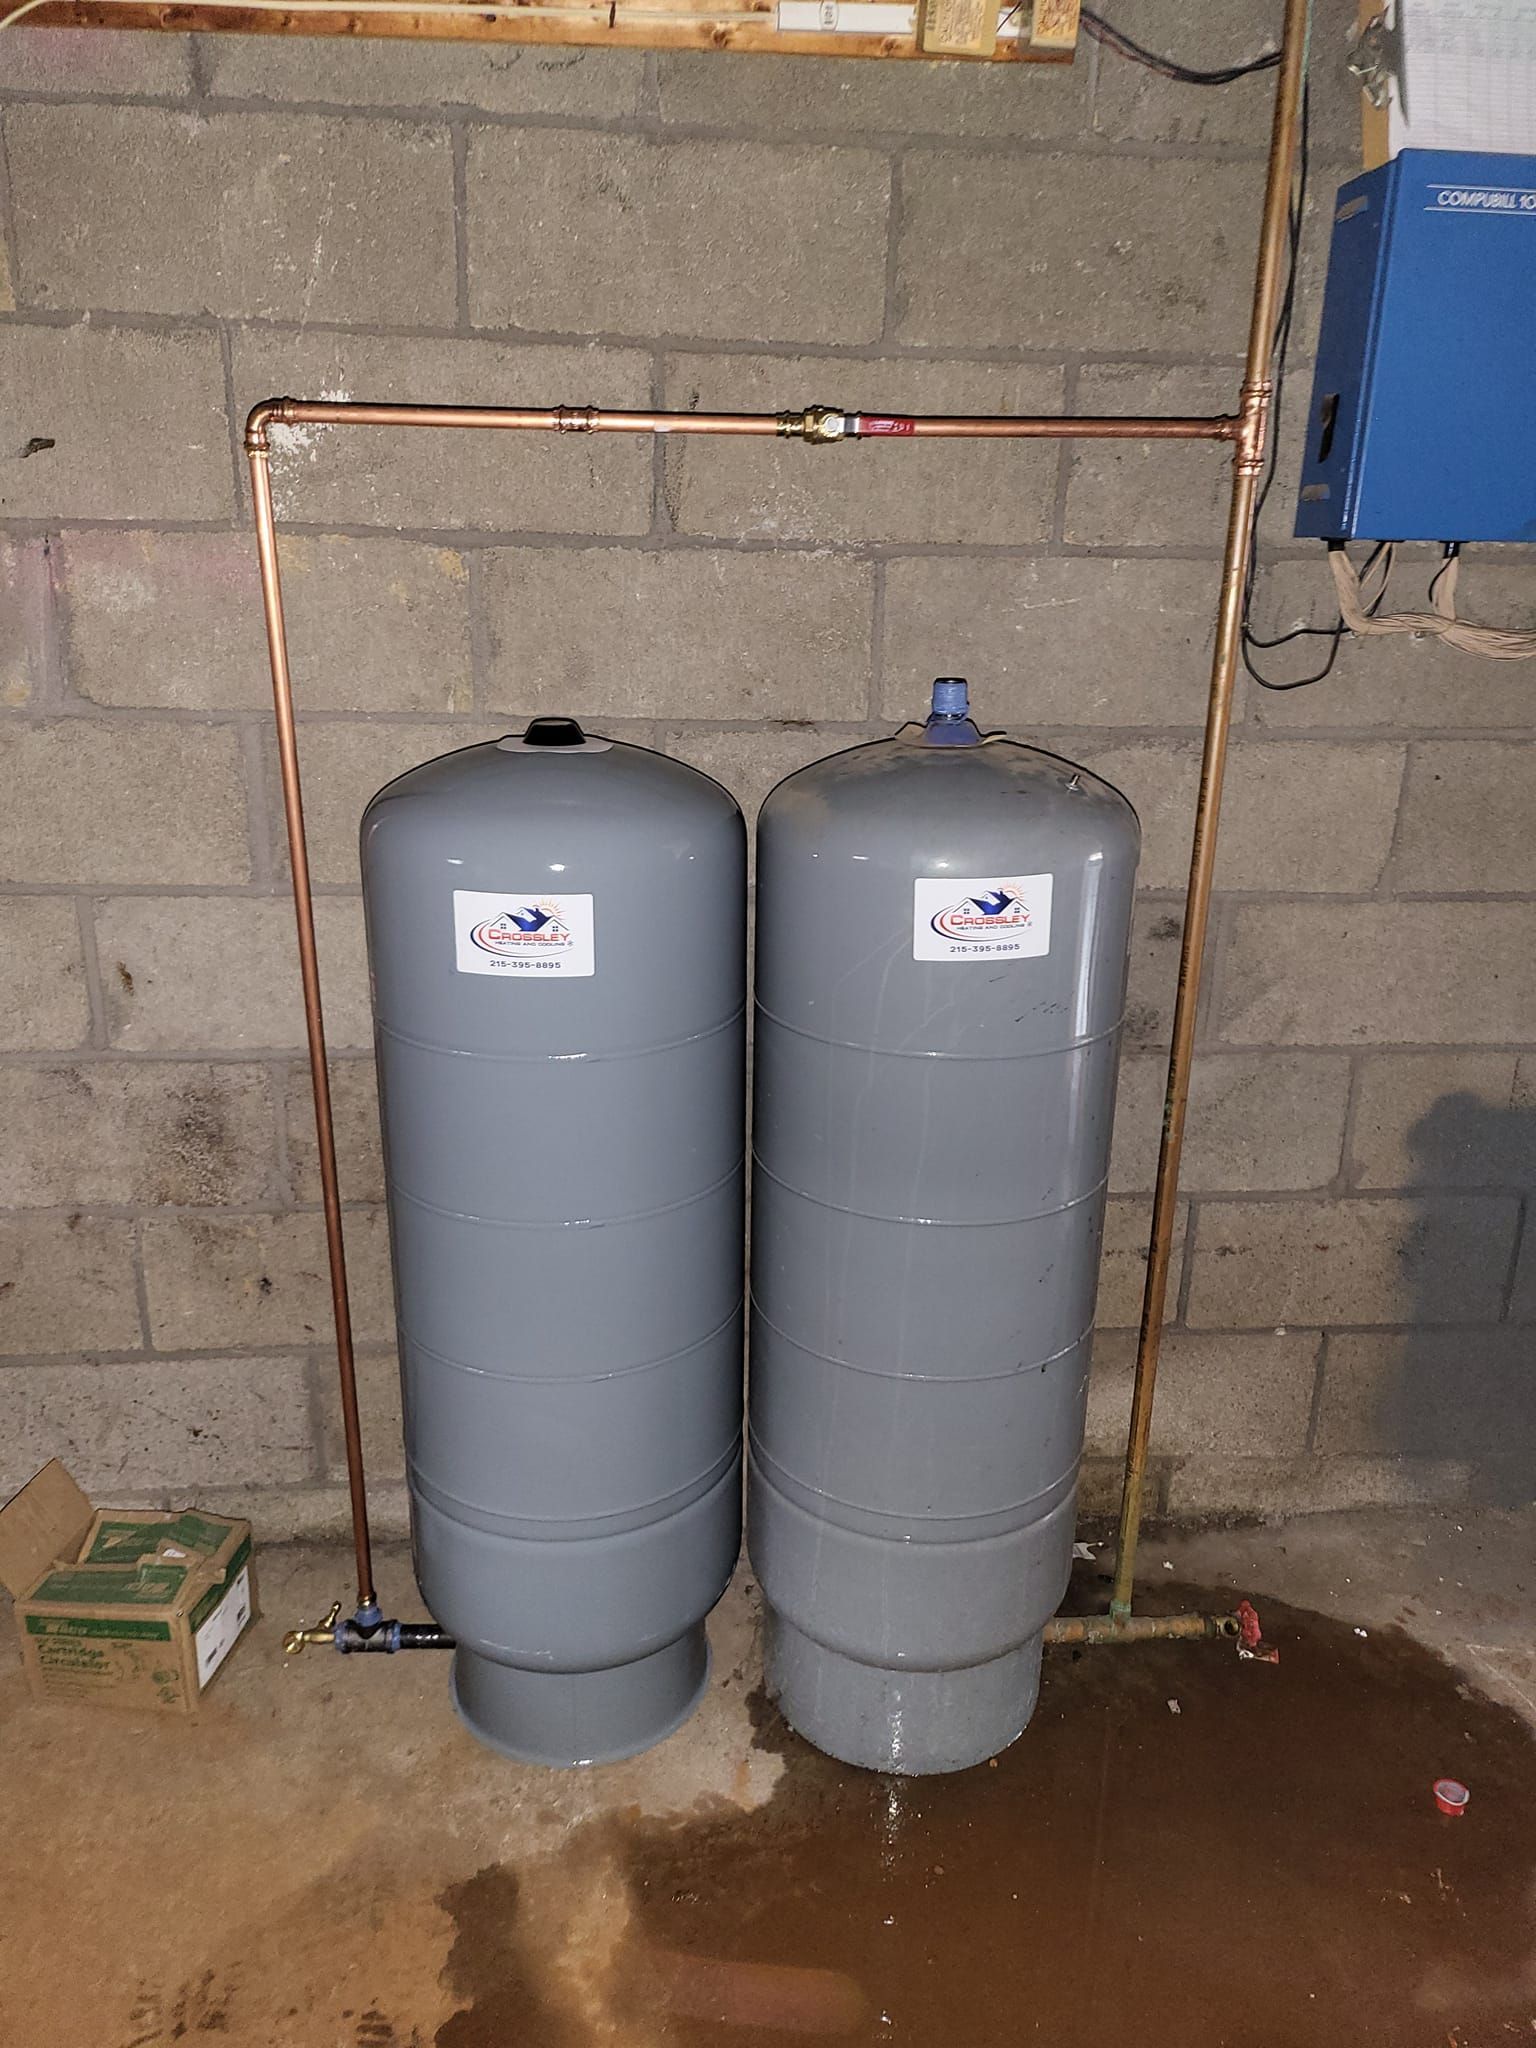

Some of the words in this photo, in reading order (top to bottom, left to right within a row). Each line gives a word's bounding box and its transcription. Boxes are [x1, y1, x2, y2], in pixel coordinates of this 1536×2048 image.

[1437, 190, 1518, 209] COMPUBILL
[950, 914, 1031, 926] CROSSLEY
[488, 929, 570, 941] CROSSLEY
[950, 943, 1020, 953] 215-395-8895
[489, 959, 562, 969] 215-395-8895
